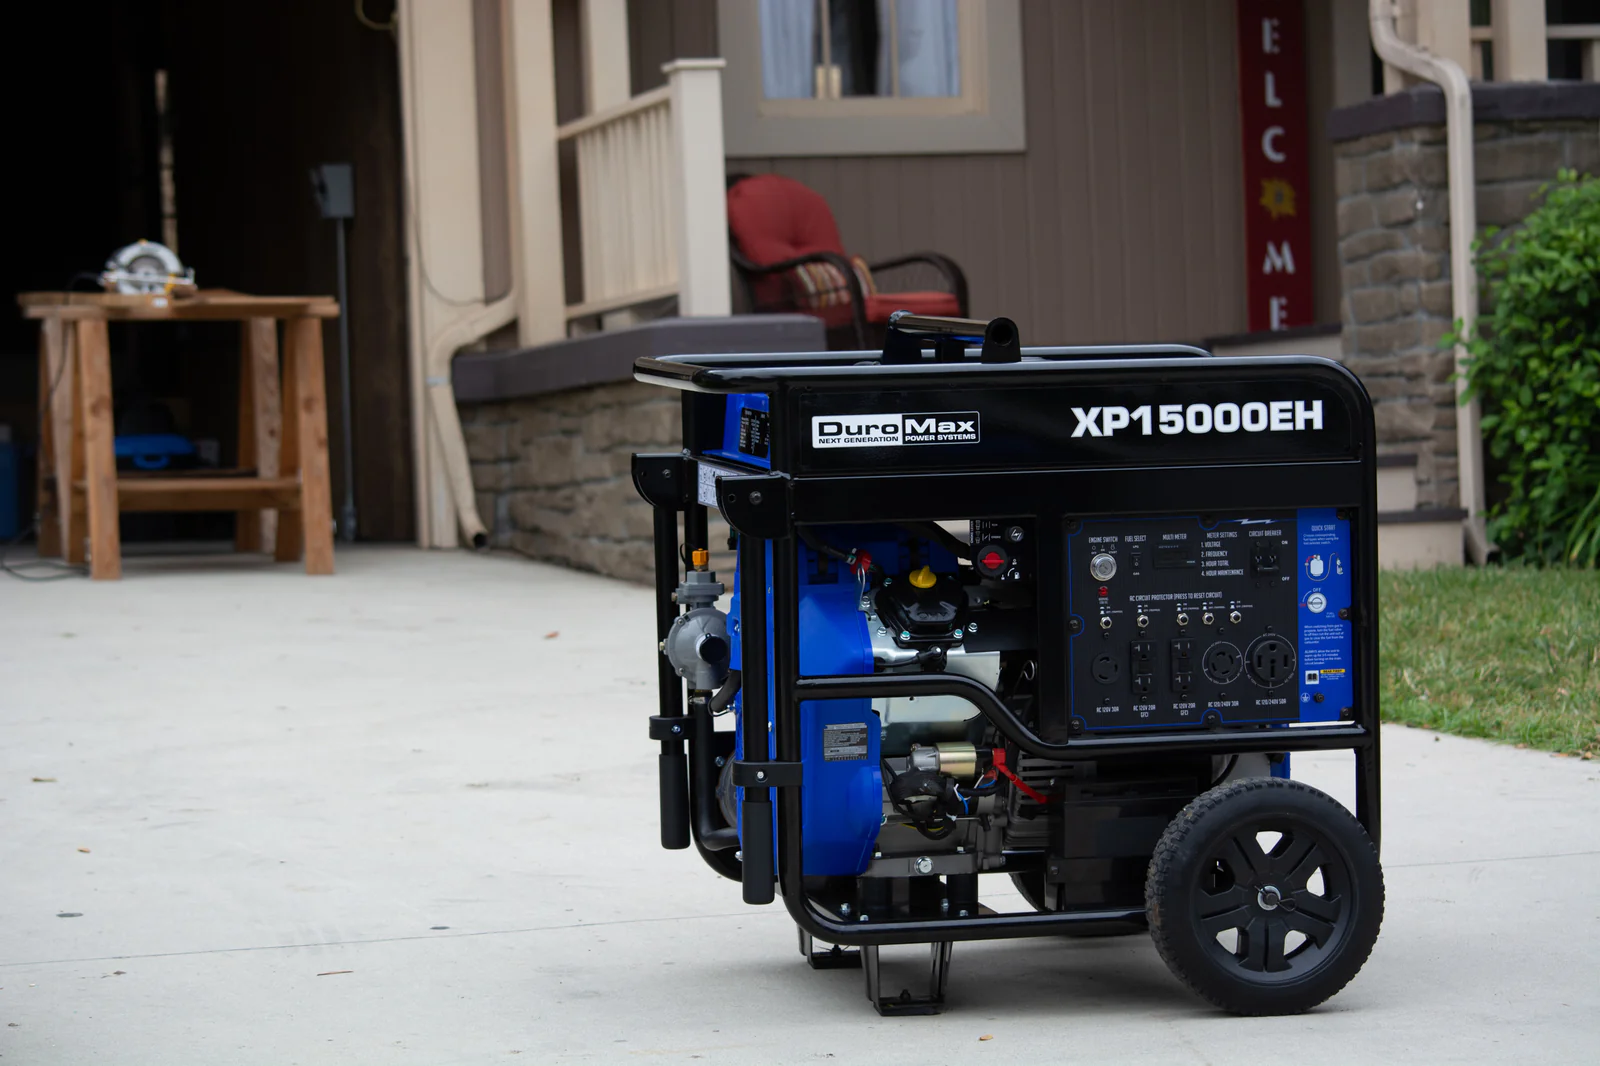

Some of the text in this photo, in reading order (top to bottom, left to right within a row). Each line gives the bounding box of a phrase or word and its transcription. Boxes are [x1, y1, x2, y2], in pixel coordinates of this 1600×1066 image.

[1070, 399, 1324, 438] XP15000EH
[905, 433, 977, 442] POWER SYSTEMS
